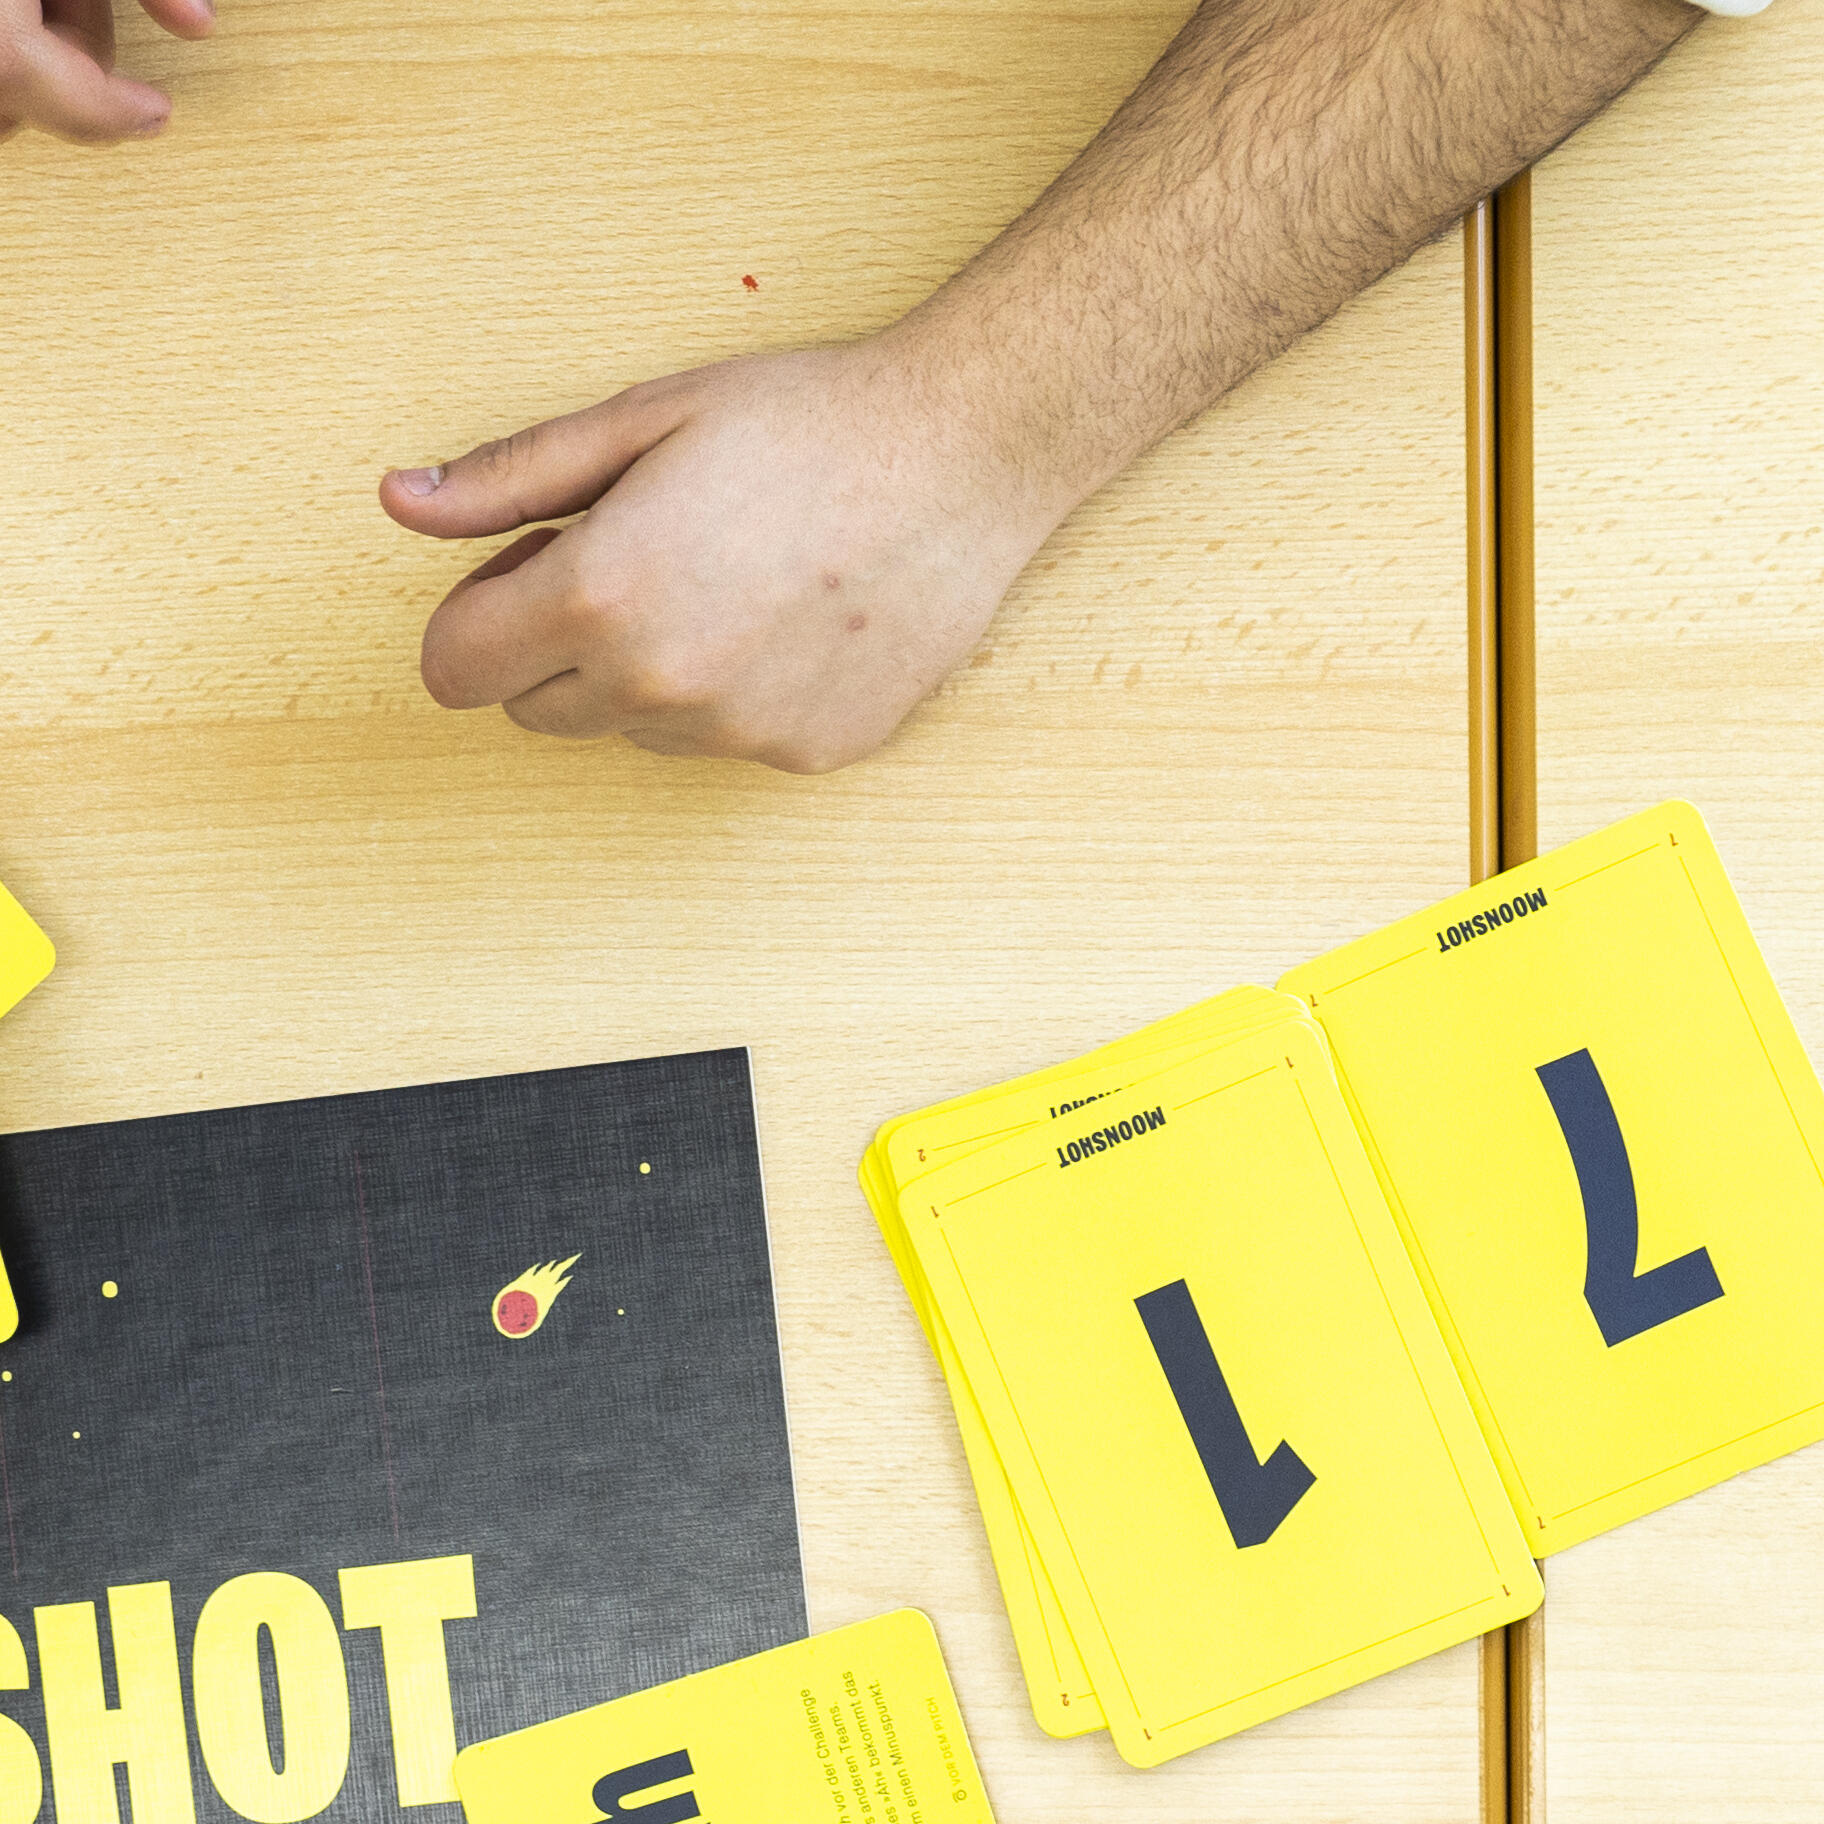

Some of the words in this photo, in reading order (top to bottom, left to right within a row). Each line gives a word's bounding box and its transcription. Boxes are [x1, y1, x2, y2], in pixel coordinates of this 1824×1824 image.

[1436, 887, 1548, 953] MOONSHOT
[1056, 1106, 1166, 1169] MOONSHOT
[1534, 1047, 1726, 1348] 7
[1133, 1278, 1318, 1550] 1
[801, 1689, 830, 1759] Challenge
[868, 1680, 903, 1766] Minuspunkt.
[823, 1764, 838, 1785] der
[832, 1791, 846, 1811] vor
[846, 1756, 871, 1813] anderen
[898, 1769, 917, 1807] einen
